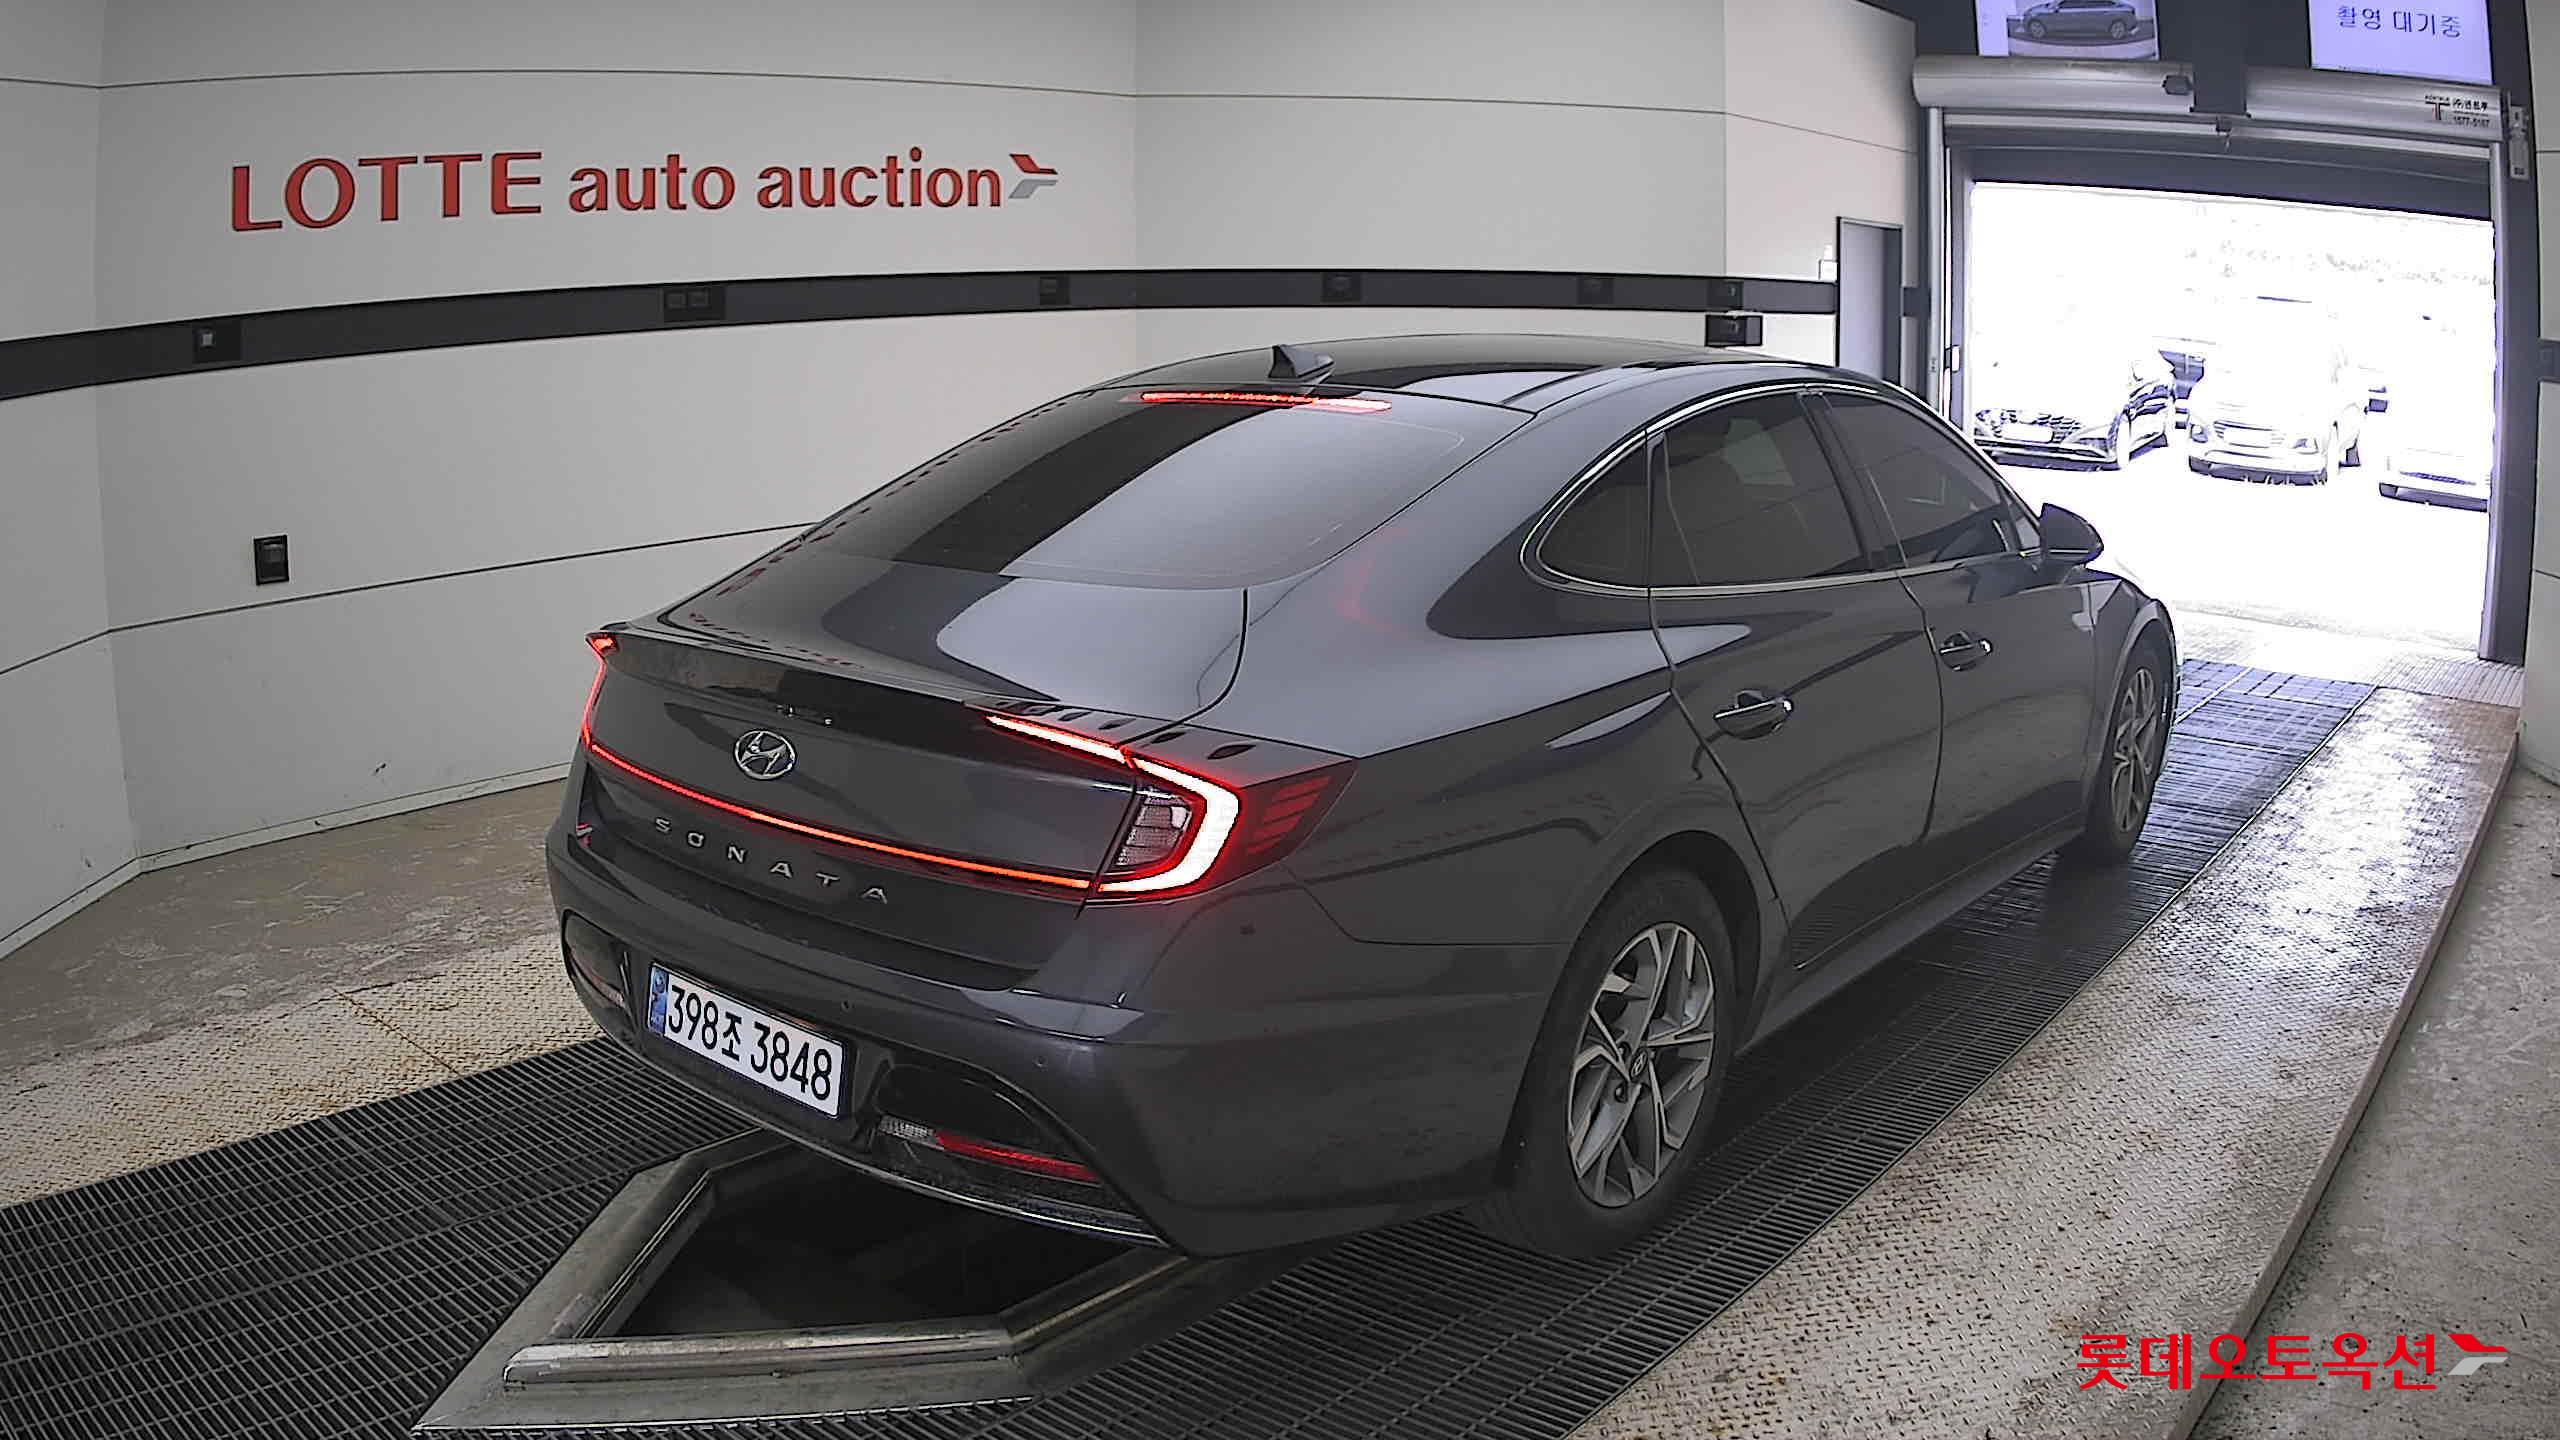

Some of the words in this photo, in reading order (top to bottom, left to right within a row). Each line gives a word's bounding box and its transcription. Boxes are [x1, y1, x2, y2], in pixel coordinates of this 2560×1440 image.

[2338, 6, 2382, 30] 촬영
[2393, 11, 2461, 38] 대기중
[232, 151, 543, 232] LOTTE
[568, 153, 737, 212] auto
[757, 147, 1002, 208] auction
[654, 816, 888, 904] SONATA
[668, 984, 742, 1062] 398조
[750, 1021, 833, 1101] 3848
